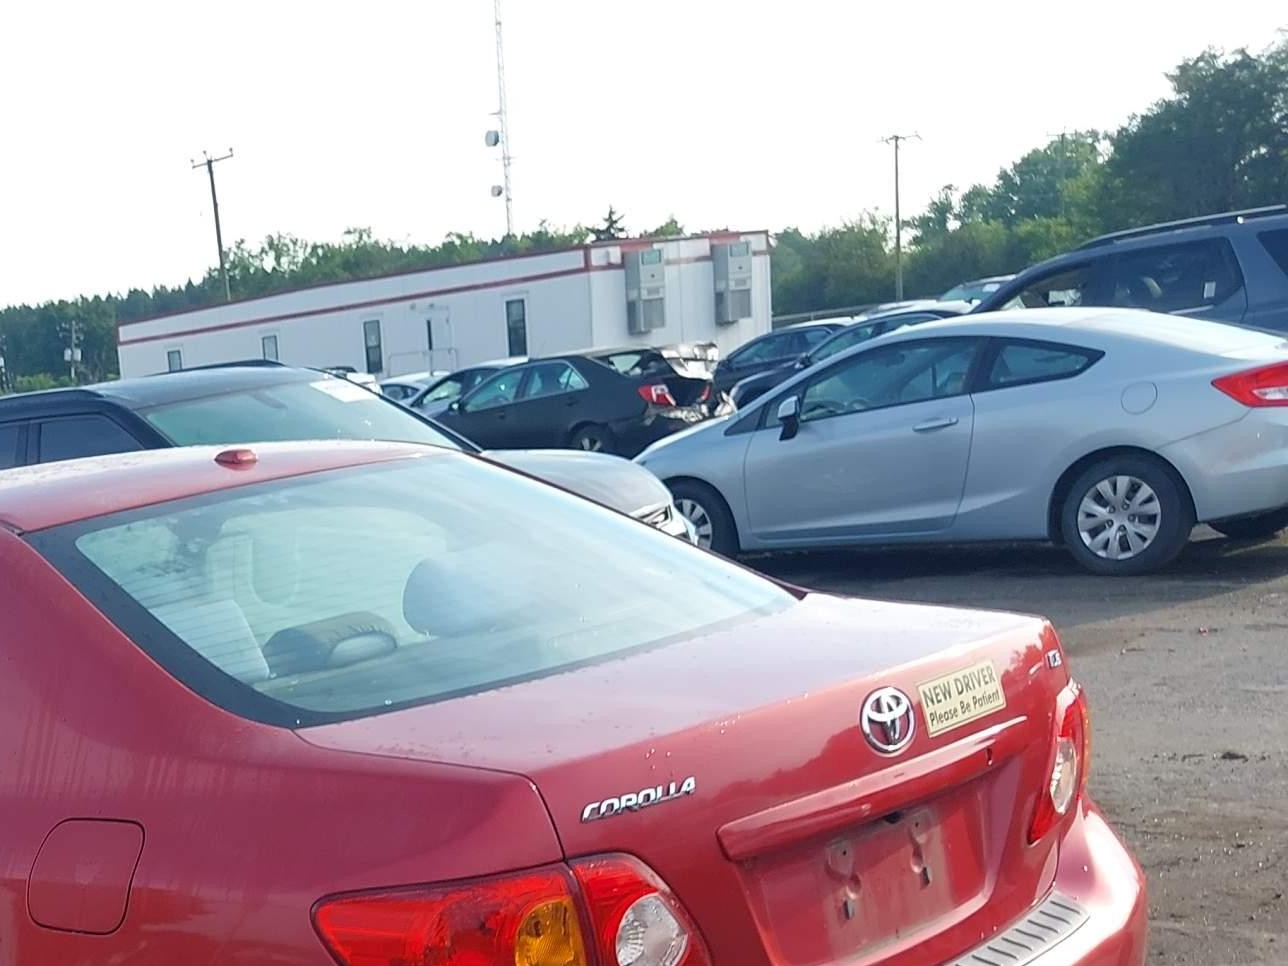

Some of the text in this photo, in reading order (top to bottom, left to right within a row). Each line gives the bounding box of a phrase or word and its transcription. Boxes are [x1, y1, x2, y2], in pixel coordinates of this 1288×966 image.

[922, 665, 996, 708] NEW DRIVER
[929, 690, 1000, 726] Please Be Patient
[580, 776, 696, 823] COROLLA
